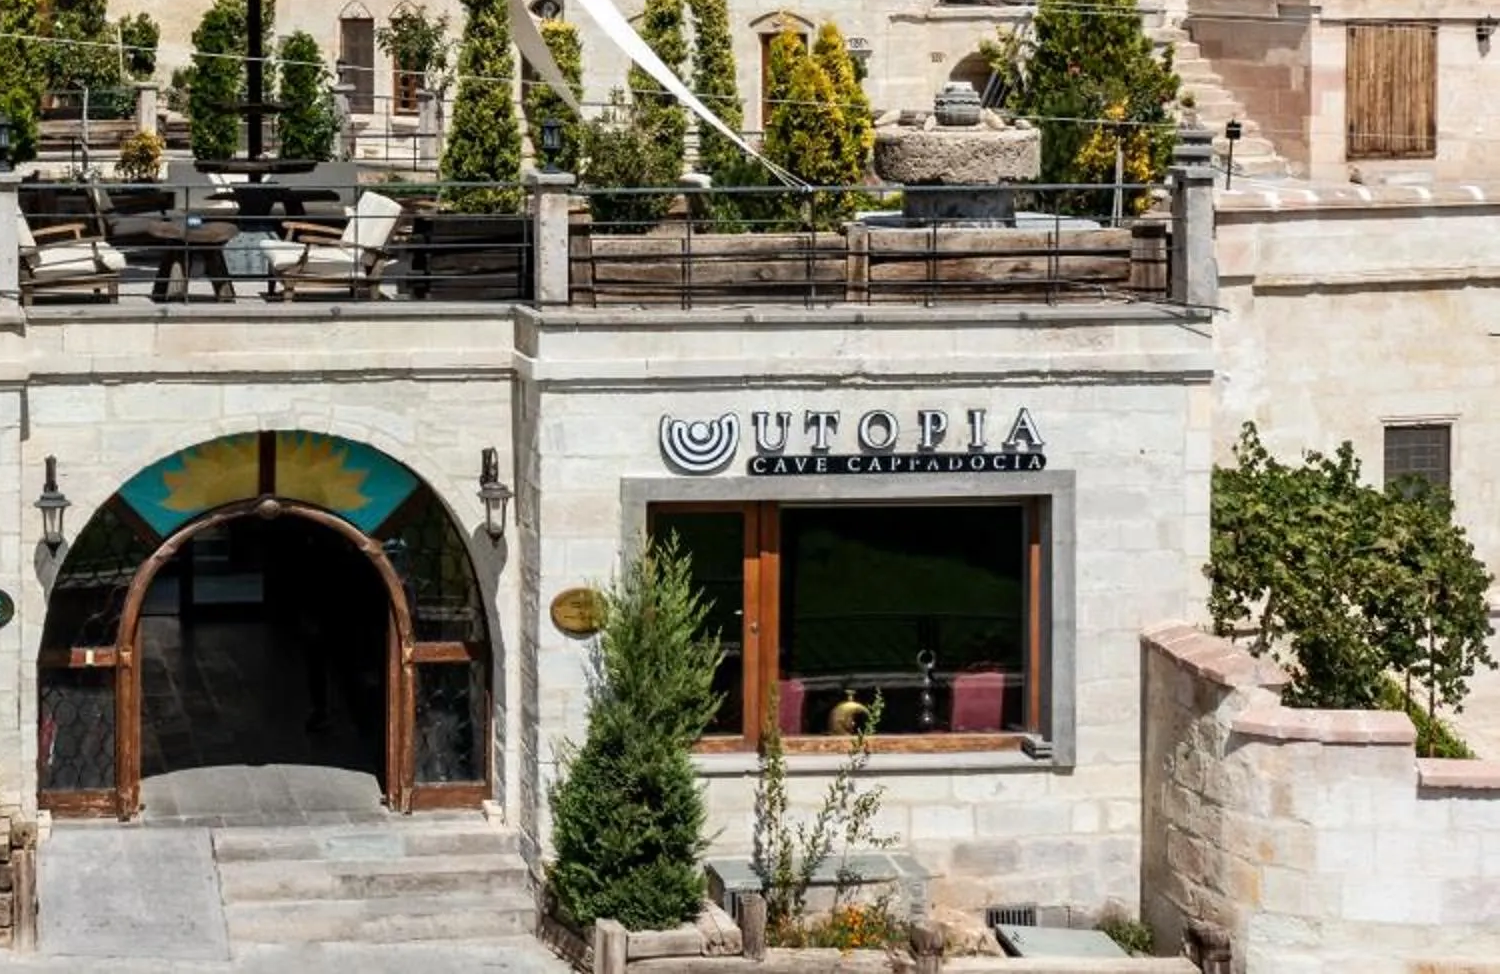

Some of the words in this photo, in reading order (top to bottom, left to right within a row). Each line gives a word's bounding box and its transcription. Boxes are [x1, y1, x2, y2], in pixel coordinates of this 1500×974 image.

[751, 407, 1045, 455] UTOPIA
[752, 456, 829, 474] CAVE
[846, 454, 1043, 472] CAPPADOCIA
